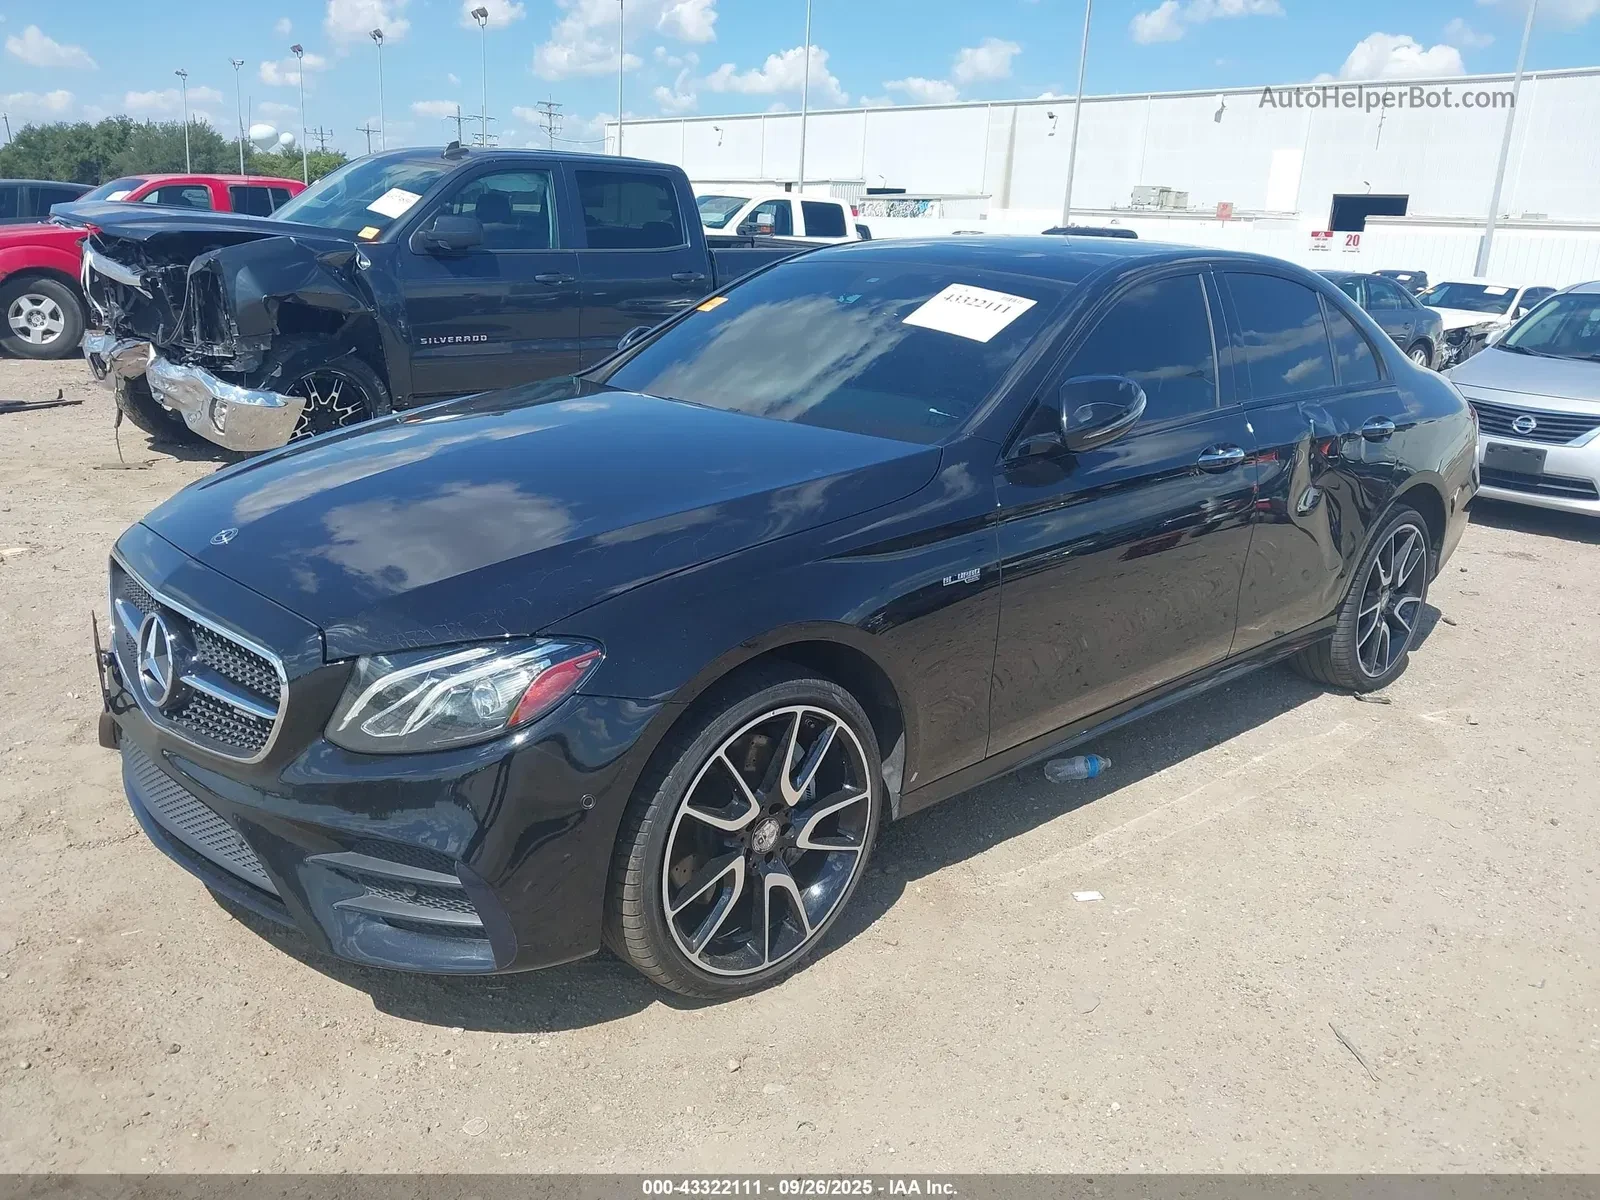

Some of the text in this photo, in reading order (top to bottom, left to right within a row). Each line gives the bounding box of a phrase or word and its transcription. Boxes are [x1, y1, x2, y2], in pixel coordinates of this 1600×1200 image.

[1345, 234, 1360, 246] 20
[943, 293, 1012, 314] 43322111
[420, 335, 488, 345] SILVERADO
